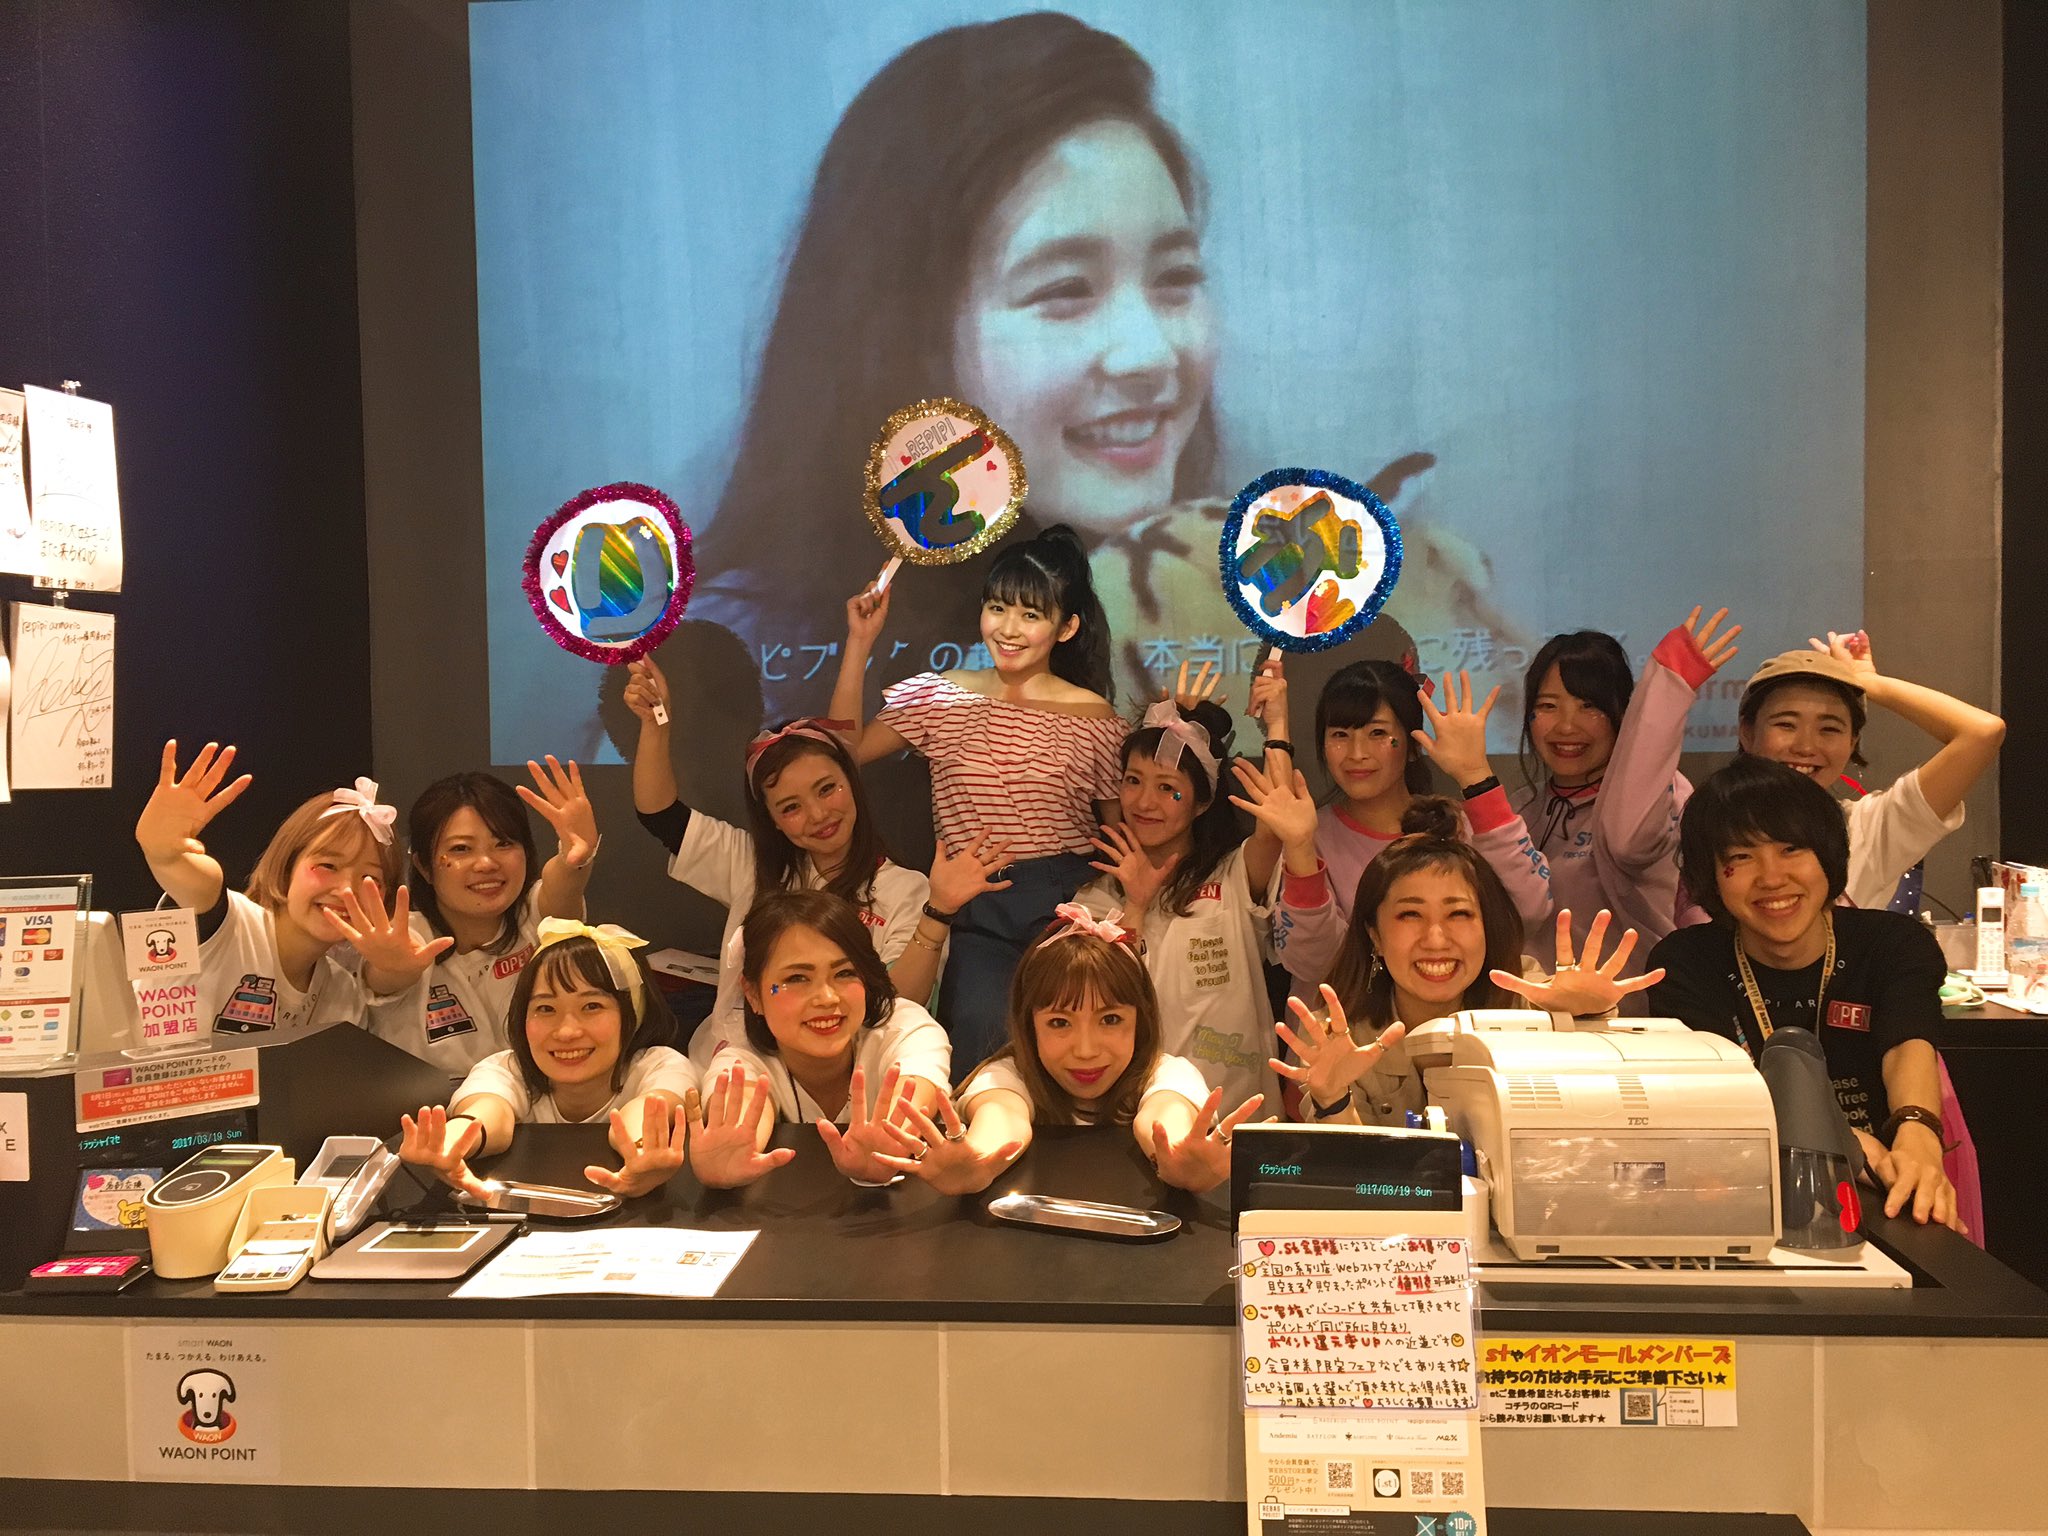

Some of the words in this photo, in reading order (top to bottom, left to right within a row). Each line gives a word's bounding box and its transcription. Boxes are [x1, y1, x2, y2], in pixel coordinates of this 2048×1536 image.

[905, 417, 956, 461] REPIPI
[24, 914, 53, 926] VISA
[1190, 936, 1224, 949] Please
[1188, 951, 1210, 963] feel
[1212, 948, 1229, 959] free
[139, 965, 164, 973] WAON
[165, 962, 188, 971] POINT
[1194, 965, 1206, 976] to
[1207, 961, 1229, 974] look
[1196, 972, 1230, 988] around
[138, 985, 197, 1003] WAON
[142, 1000, 197, 1020] POINT
[1832, 1004, 1871, 1028] OPEN
[143, 1017, 198, 1039] 加盟店
[135, 1064, 164, 1073] WAON
[1839, 1092, 1869, 1105] free
[1627, 1117, 1650, 1126] TEC
[172, 1132, 223, 1149] 2017/03/19
[227, 1129, 243, 1140] Sun
[1258, 1163, 1302, 1176] イラッシャイマセ
[1355, 1184, 1411, 1197] 2017/03/19
[1415, 1187, 1433, 1197] Sun
[177, 1339, 203, 1347] smart
[206, 1339, 233, 1347] WAON
[1505, 1401, 1580, 1411] コチラのQRコード
[193, 1432, 223, 1442] WAON
[158, 1446, 207, 1460] WAON
[211, 1447, 257, 1461] POINT
